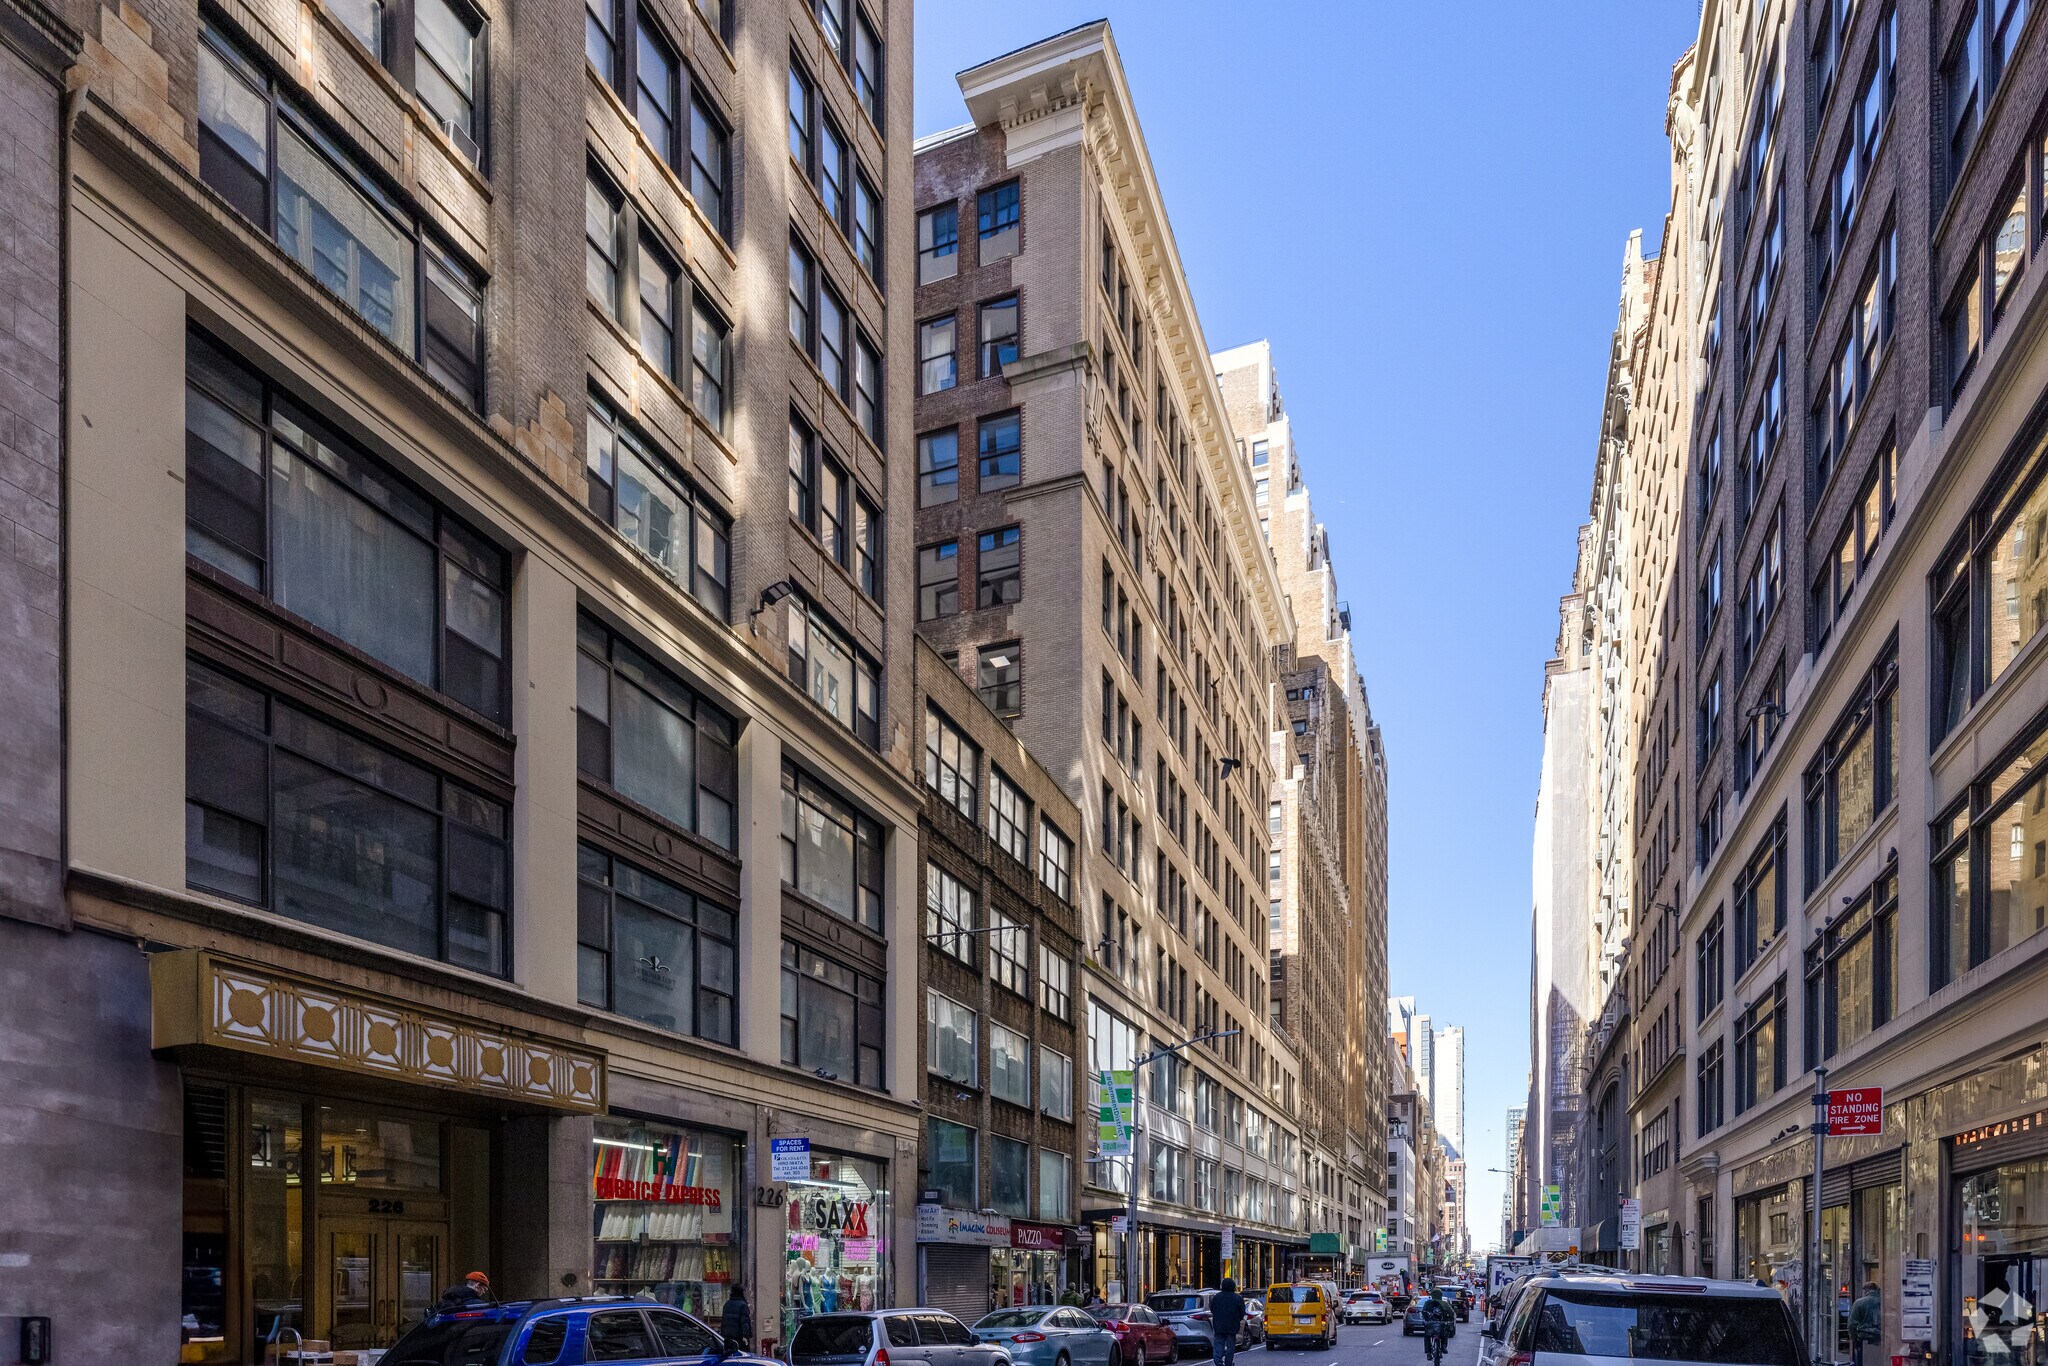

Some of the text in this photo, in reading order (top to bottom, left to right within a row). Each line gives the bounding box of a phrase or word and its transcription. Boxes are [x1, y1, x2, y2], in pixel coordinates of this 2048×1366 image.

[1846, 1092, 1862, 1103] NO
[1106, 1076, 1124, 1137] #GarmentDistrict
[1830, 1103, 1879, 1115] STANDING
[1830, 1114, 1880, 1124] FIRE ZONE
[597, 1177, 720, 1206] FABRICS EXPRESS
[757, 1187, 784, 1206] 226
[368, 1199, 404, 1214] 226
[815, 1199, 868, 1233] SAXX
[959, 1221, 985, 1234] IMAGING
[1017, 1228, 1042, 1245] PAZZO
